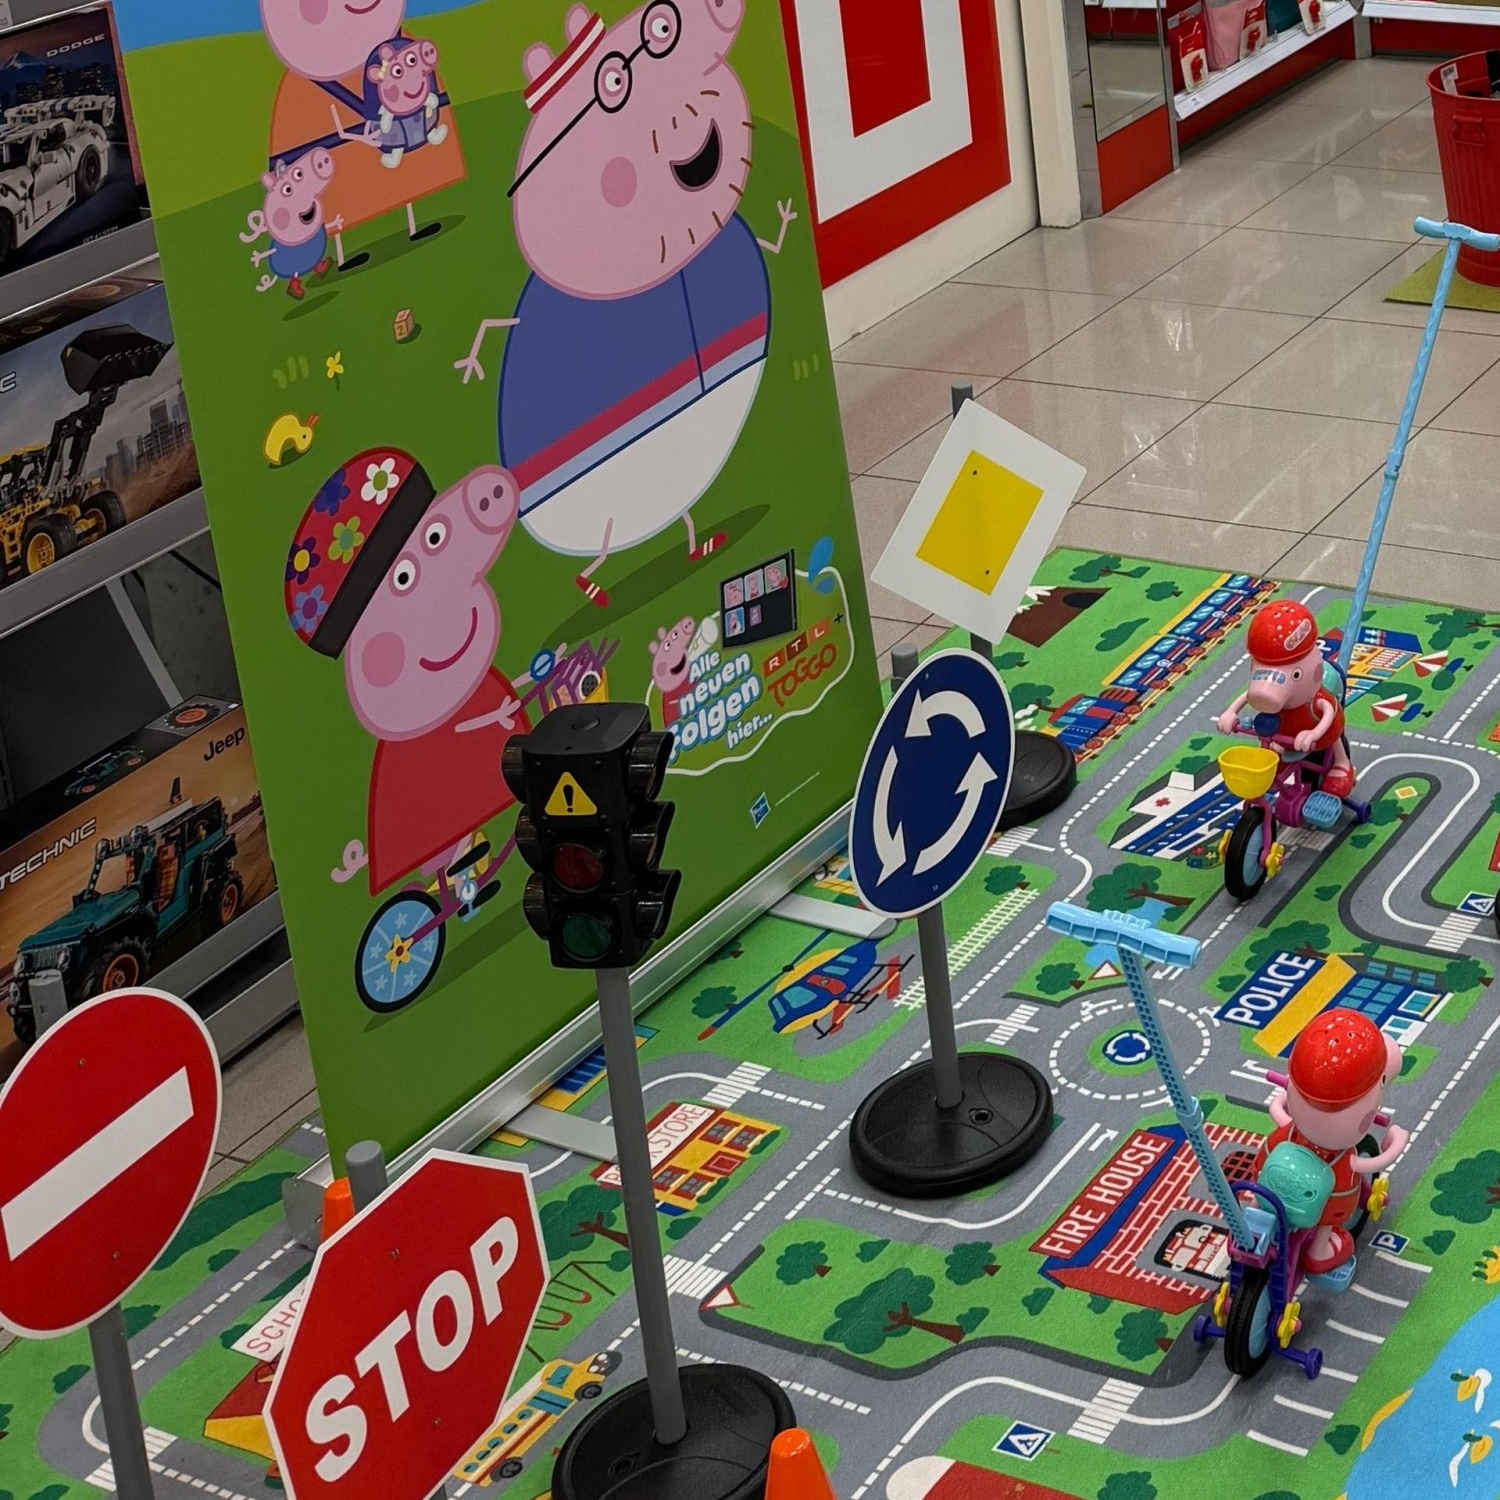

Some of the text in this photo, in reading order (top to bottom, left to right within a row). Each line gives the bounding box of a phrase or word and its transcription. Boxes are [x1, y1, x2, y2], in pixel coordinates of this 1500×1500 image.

[46, 33, 106, 58] DODGE
[678, 652, 750, 716] neuen
[688, 651, 720, 683] Alle
[767, 643, 837, 708] TOGGO
[203, 725, 245, 762] Jeep
[0, 818, 97, 891] TECHNIC
[1224, 952, 1316, 1026] POLICE
[1039, 1135, 1168, 1254] FIRE HOUSE
[305, 1216, 519, 1482] STOP
